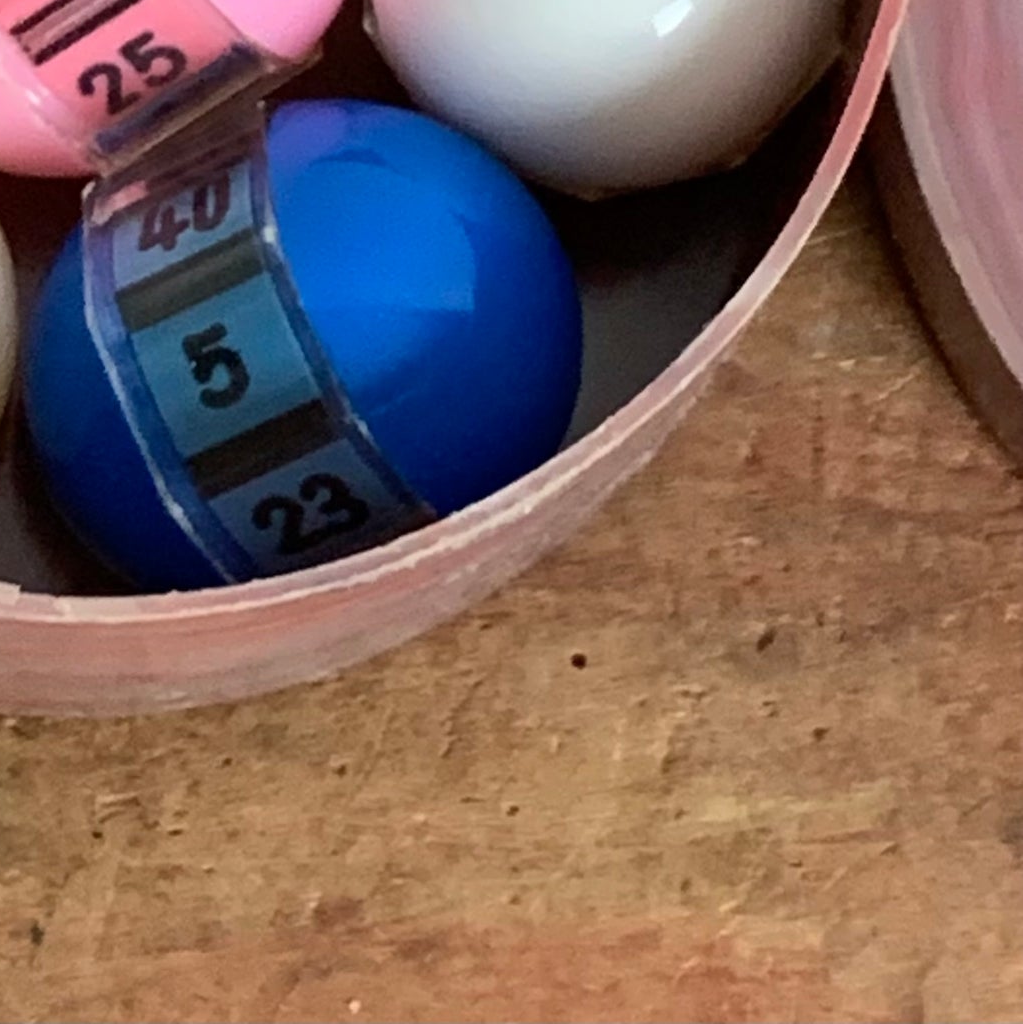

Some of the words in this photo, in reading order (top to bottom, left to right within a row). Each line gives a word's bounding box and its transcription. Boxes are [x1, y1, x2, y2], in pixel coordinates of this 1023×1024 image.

[78, 31, 187, 114] 25
[181, 322, 251, 410] 5
[251, 472, 370, 555] 23
